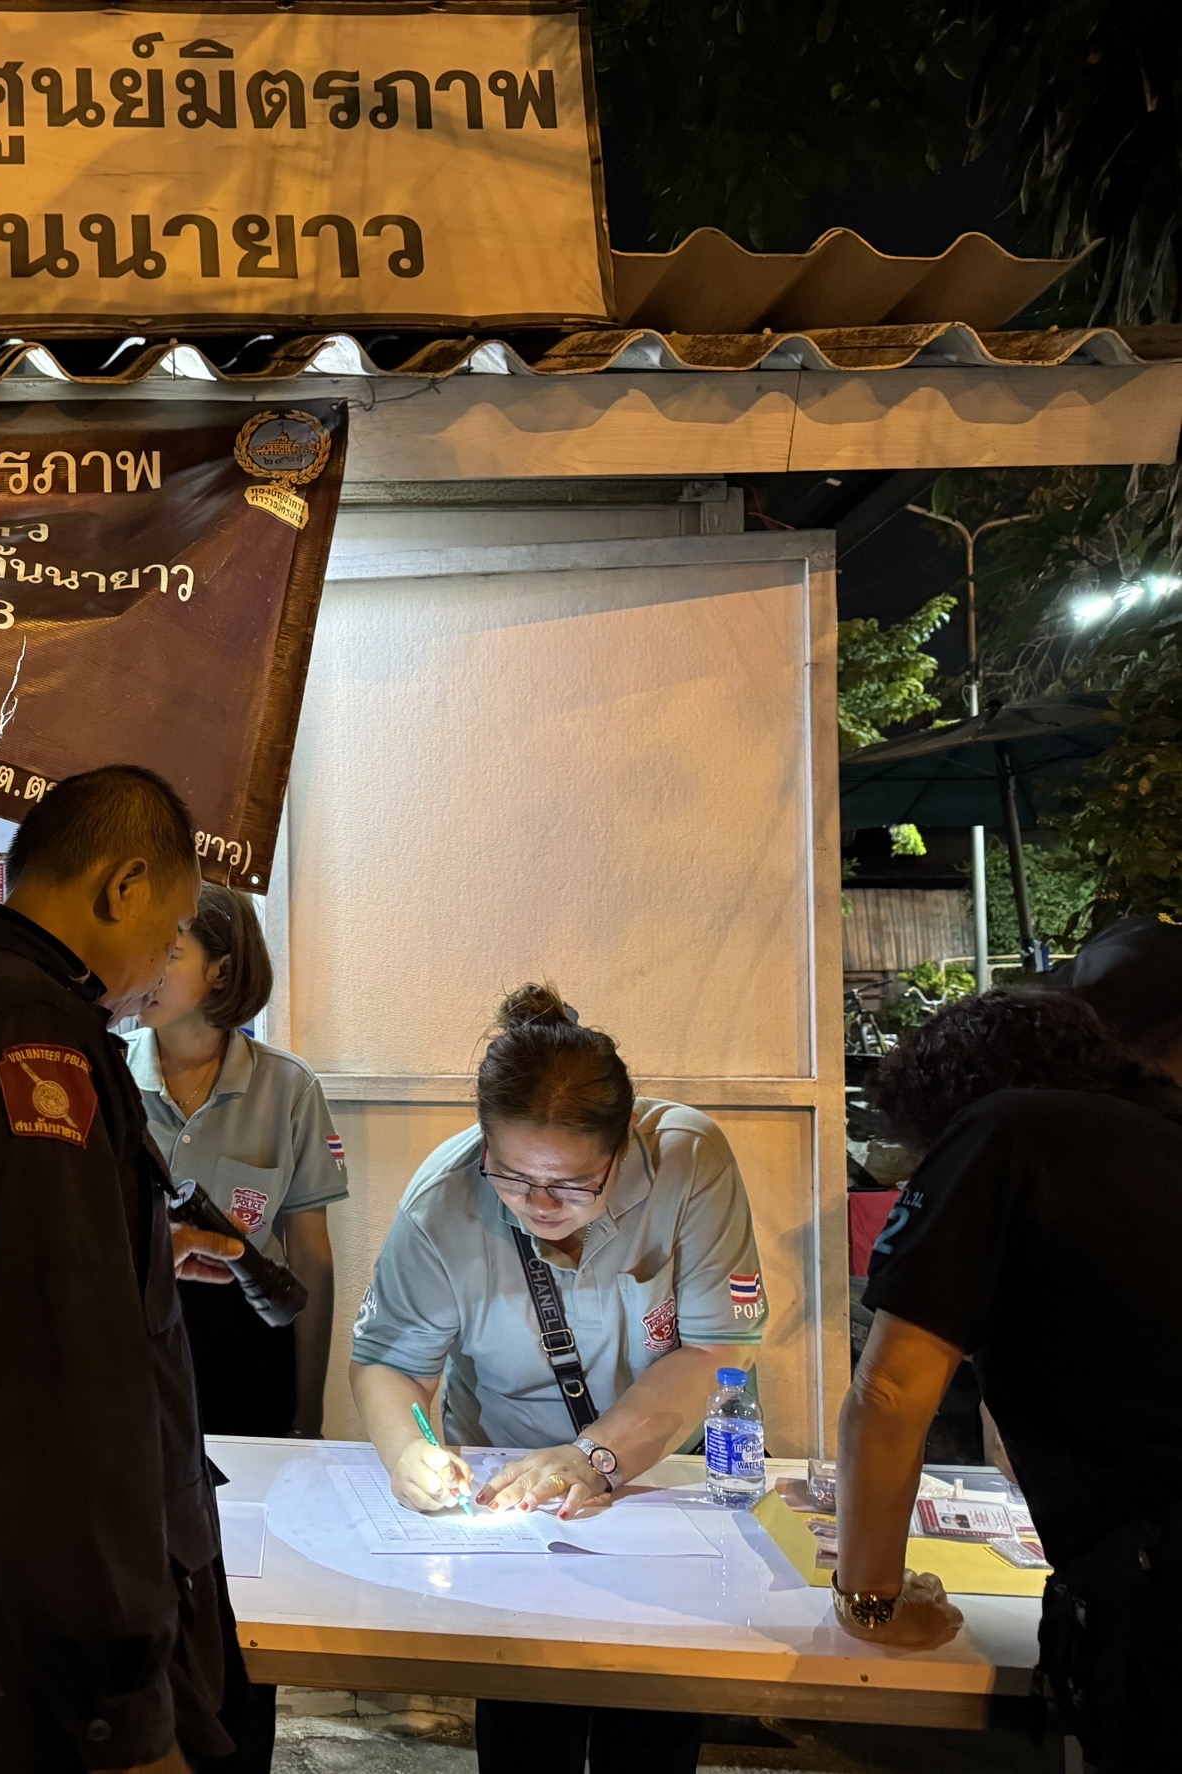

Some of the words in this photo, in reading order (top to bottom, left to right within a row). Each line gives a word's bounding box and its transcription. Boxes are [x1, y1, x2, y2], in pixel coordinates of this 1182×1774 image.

[7, 1048, 61, 1064] VOLUNTEER
[235, 1198, 263, 1211] POLICE
[528, 1257, 560, 1331] CHANEL
